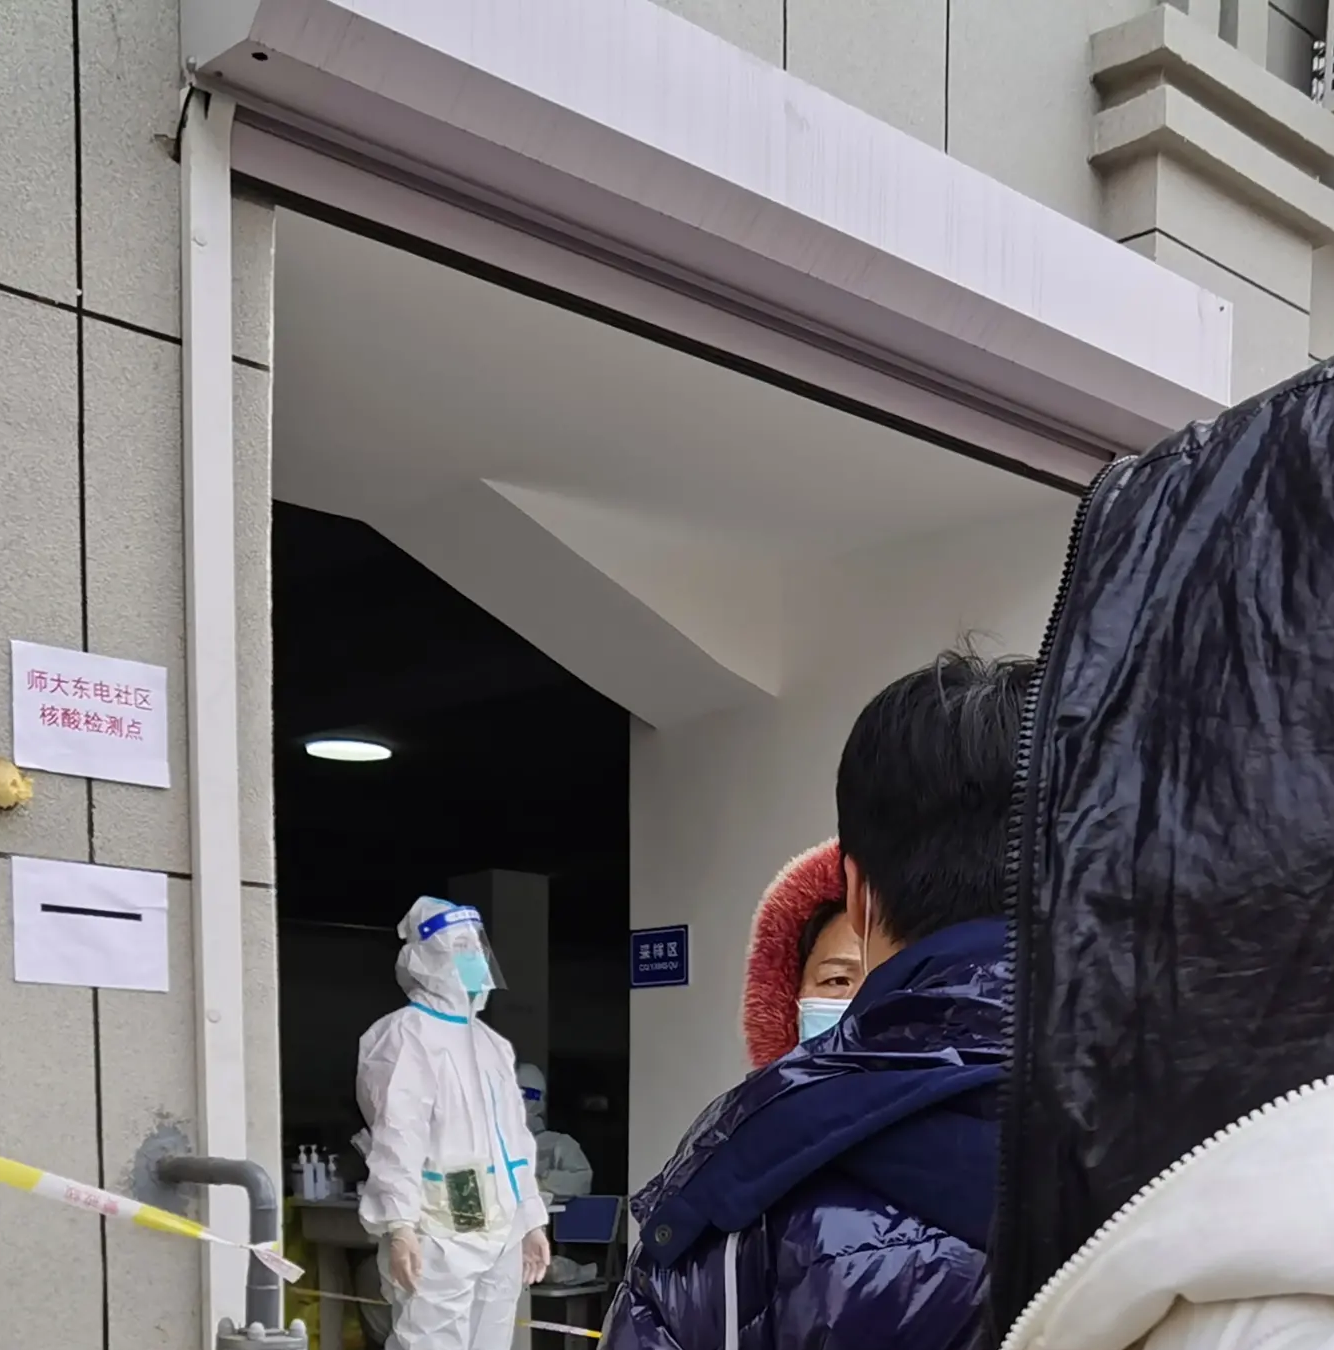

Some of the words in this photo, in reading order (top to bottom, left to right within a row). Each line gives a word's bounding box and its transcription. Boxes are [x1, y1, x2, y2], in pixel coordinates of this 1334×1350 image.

[26, 668, 153, 711] 师大东电社区
[39, 703, 144, 741] 核酸检测点
